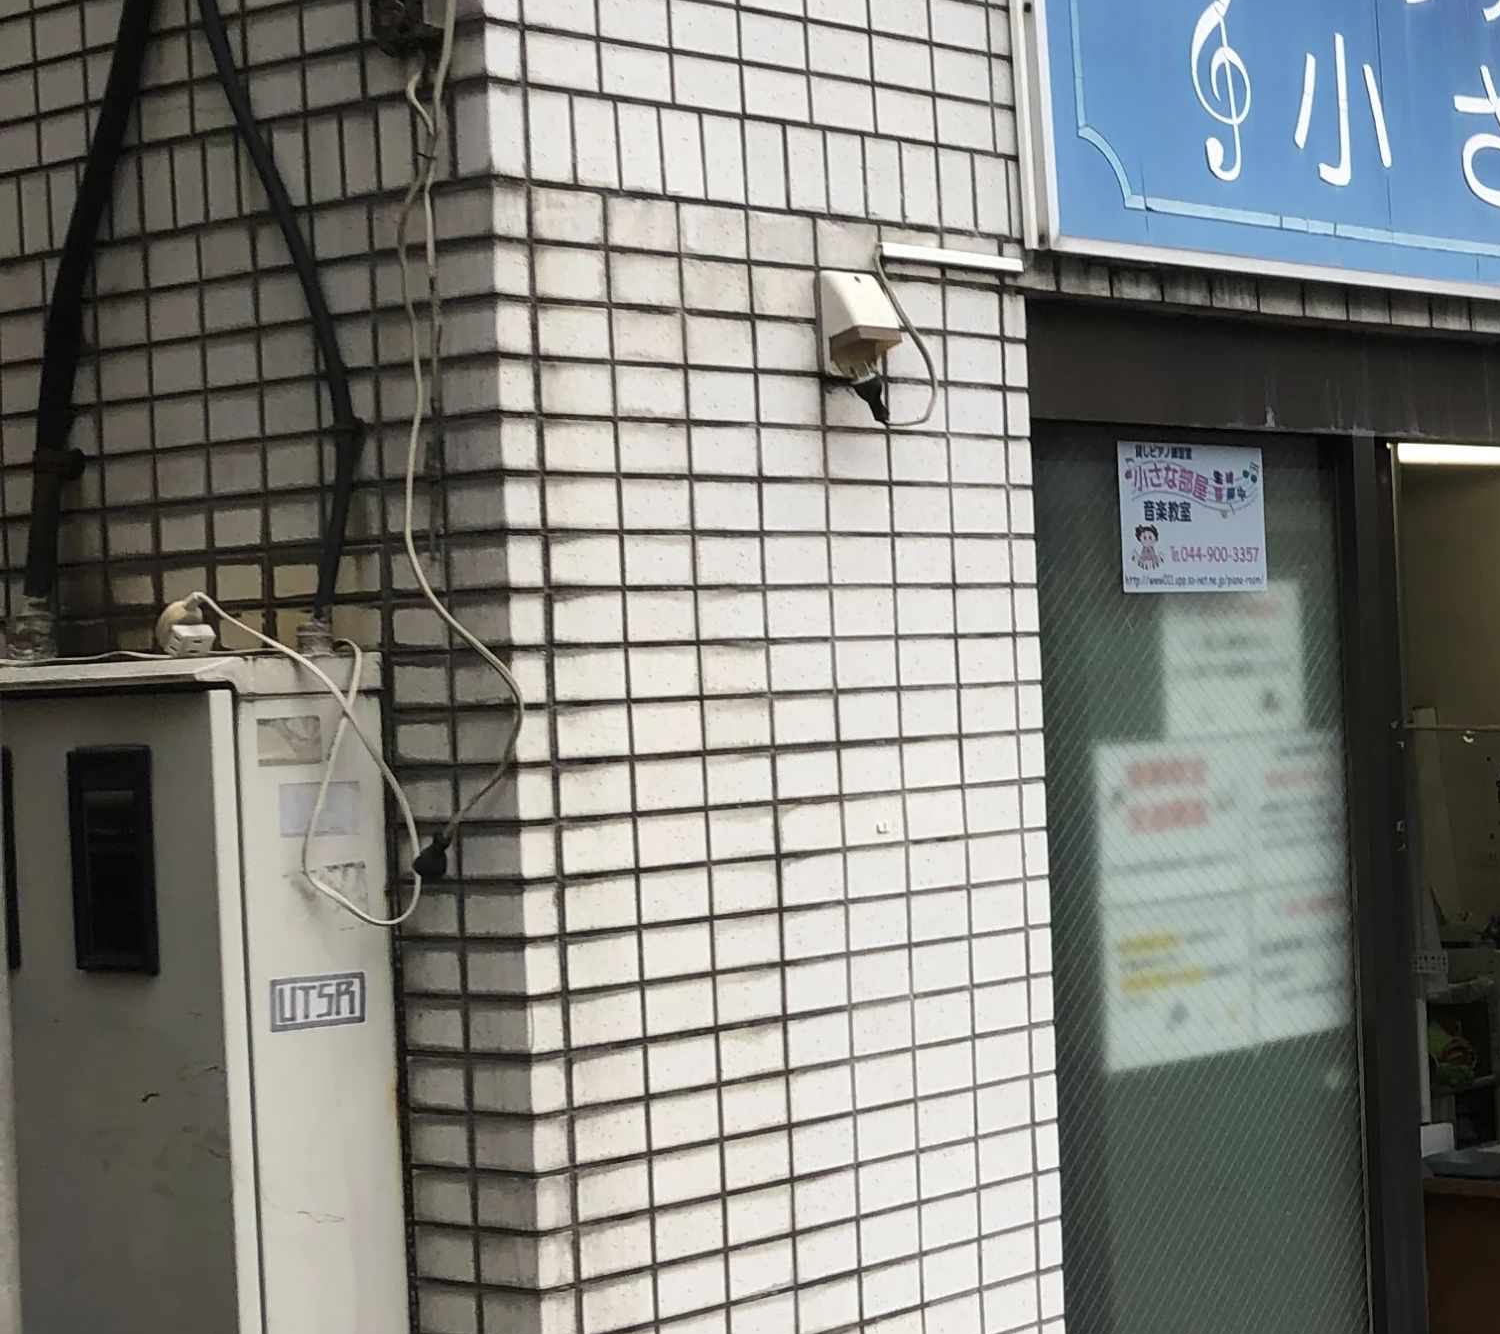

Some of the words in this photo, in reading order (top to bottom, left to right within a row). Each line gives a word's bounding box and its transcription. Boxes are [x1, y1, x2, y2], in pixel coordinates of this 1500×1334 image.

[1133, 462, 1209, 503] 小さな部屋
[1143, 500, 1192, 523] 音楽教室
